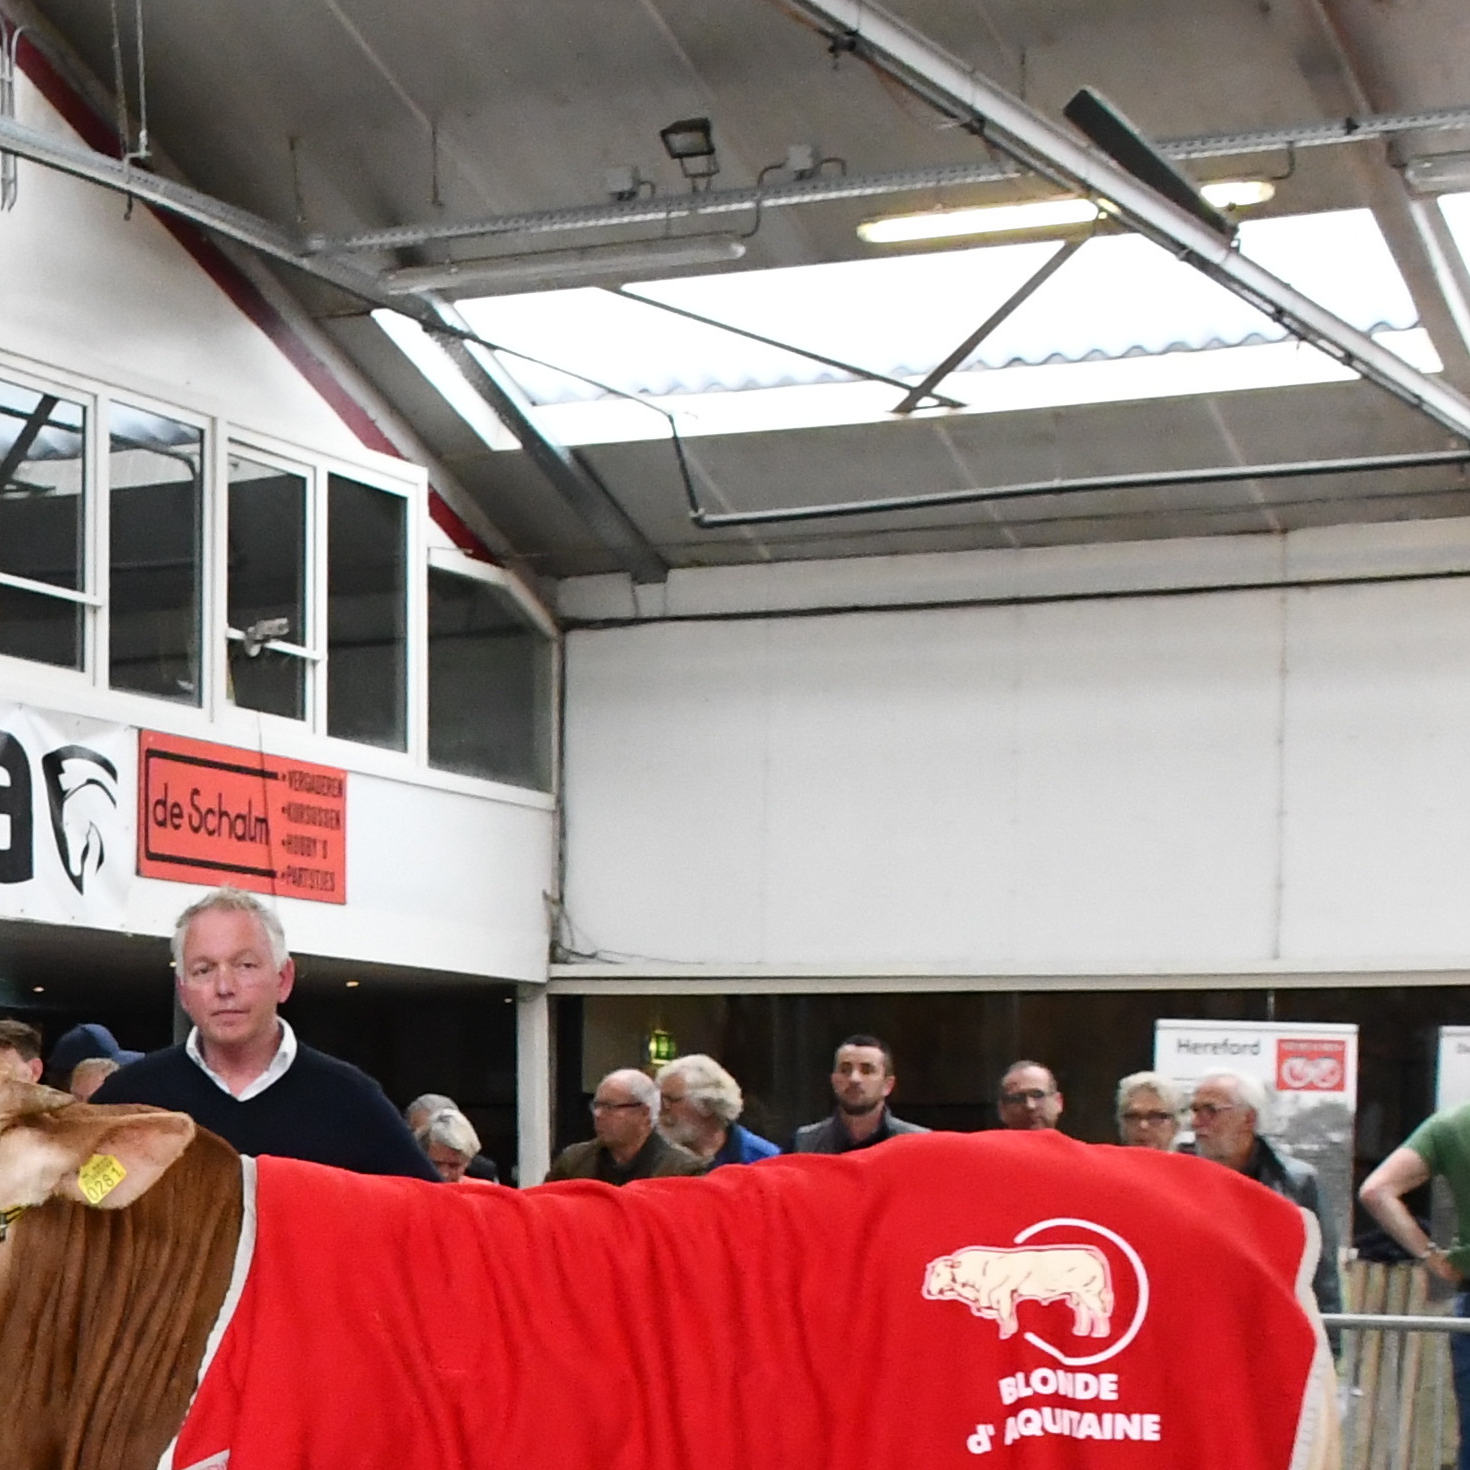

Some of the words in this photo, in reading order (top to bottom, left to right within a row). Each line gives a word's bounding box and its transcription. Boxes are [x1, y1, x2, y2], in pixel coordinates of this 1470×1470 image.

[153, 783, 184, 830] de
[189, 787, 270, 846] Schalm
[1177, 1038, 1261, 1055] Hereford
[87, 1166, 121, 1200] 0281
[999, 1367, 1119, 1405] BLONDE
[1004, 1406, 1161, 1445] AQUITAINE
